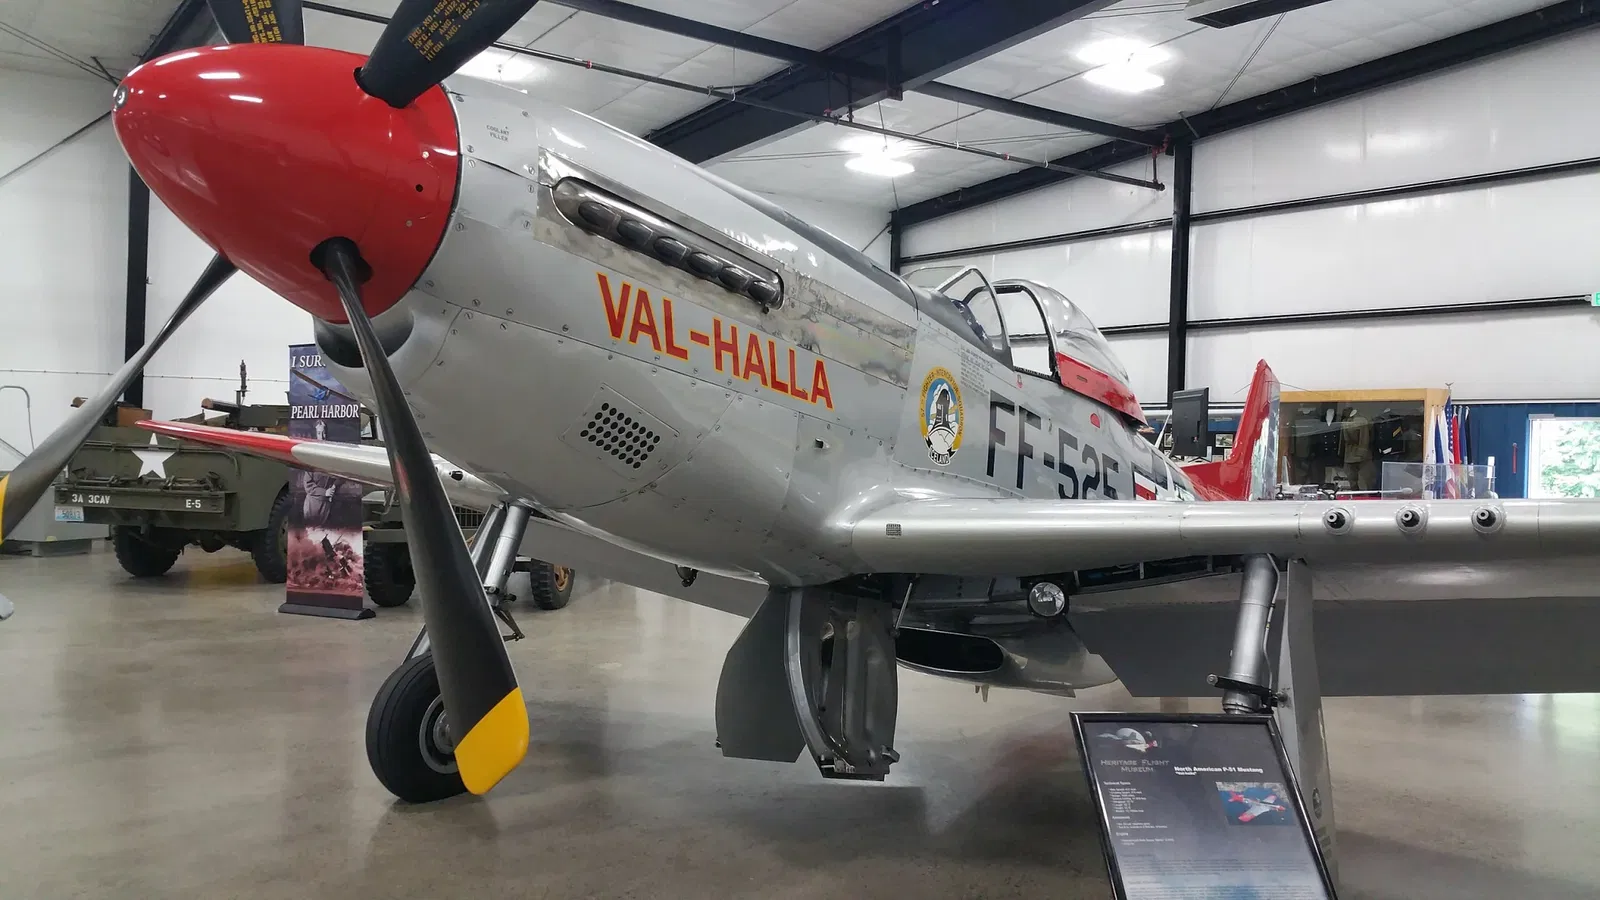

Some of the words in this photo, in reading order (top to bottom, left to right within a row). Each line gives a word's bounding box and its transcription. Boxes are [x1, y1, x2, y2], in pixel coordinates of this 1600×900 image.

[419, 39, 435, 56] LOW
[425, 42, 445, 62] HIGH
[597, 272, 834, 411] VAL-HALLA
[299, 354, 326, 368] SUR
[291, 405, 319, 419] PEARL
[321, 404, 359, 418] HARBOR
[986, 389, 1120, 500] FF-525
[72, 494, 83, 503] 3A
[88, 494, 111, 504] 3CAV
[185, 499, 201, 508] E-5
